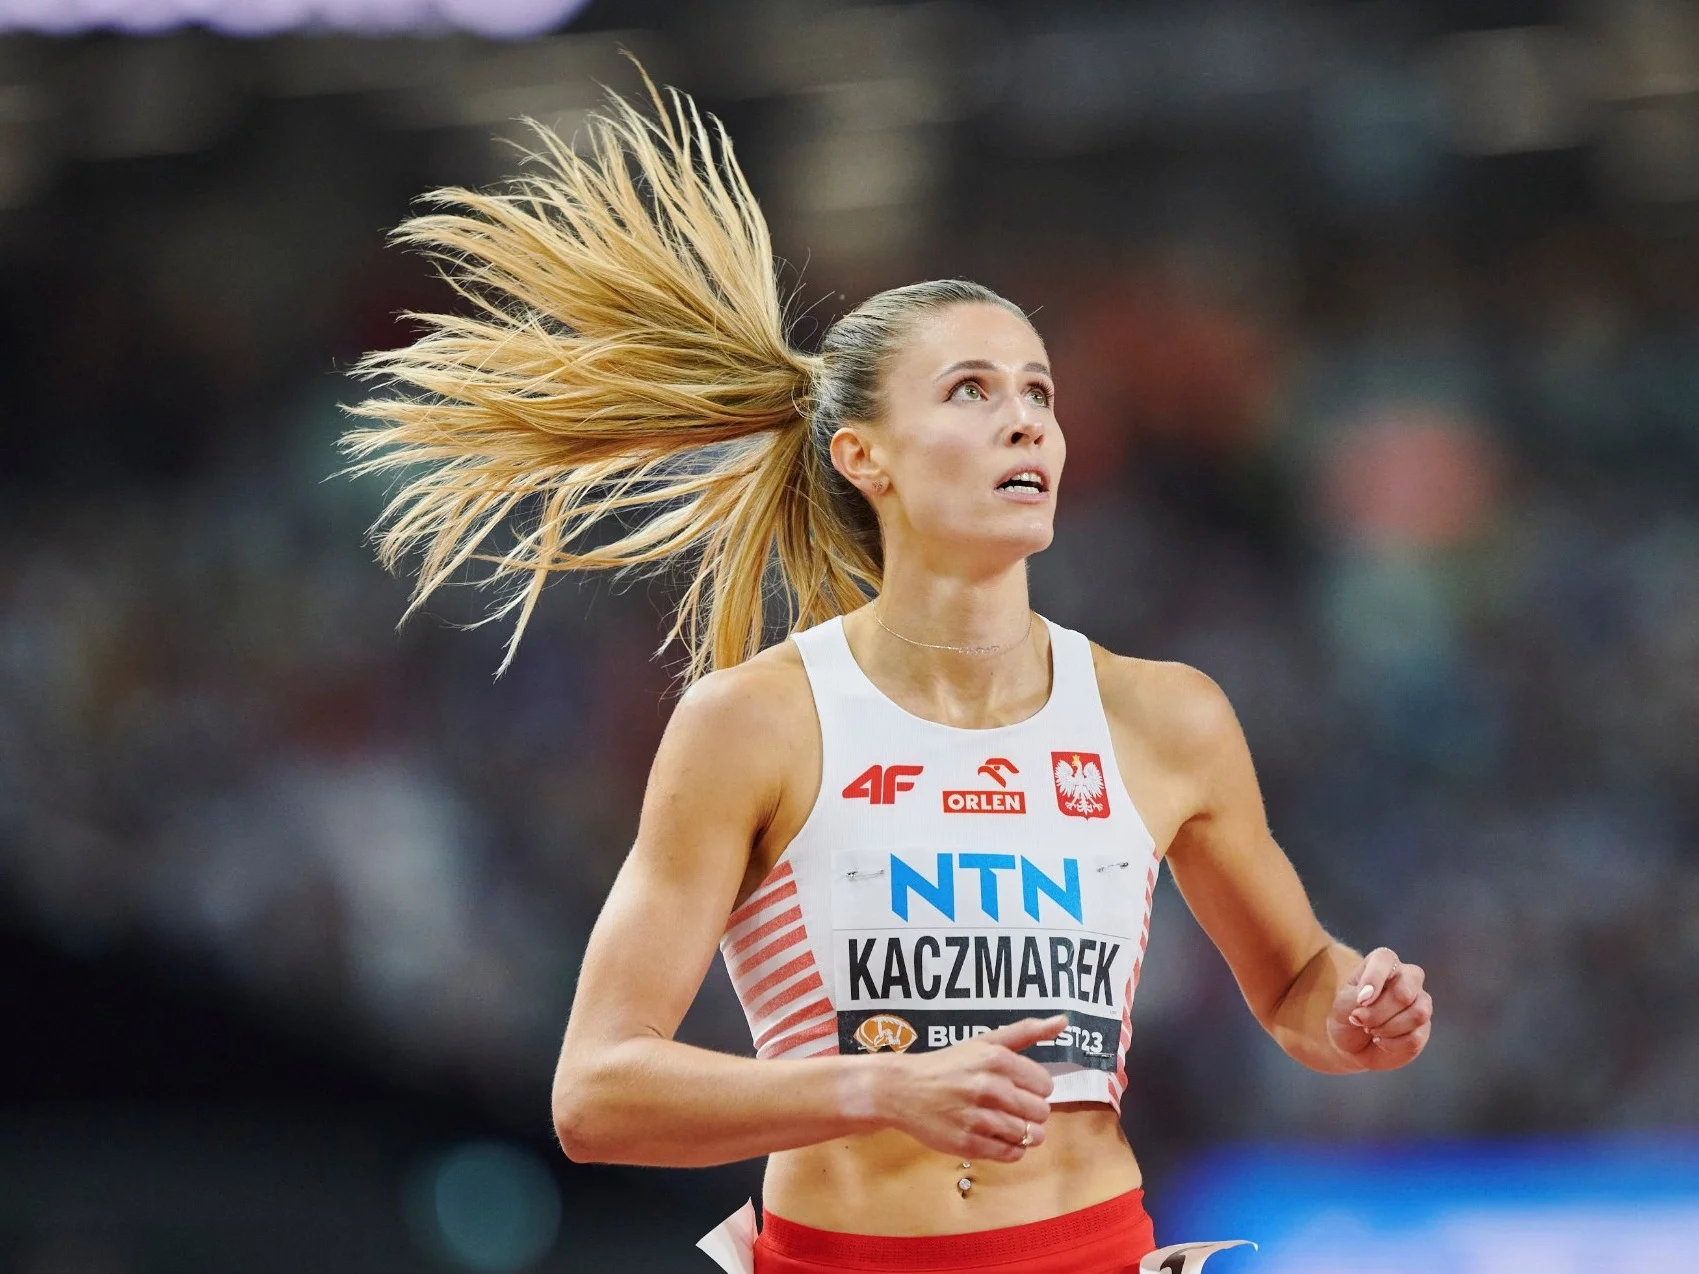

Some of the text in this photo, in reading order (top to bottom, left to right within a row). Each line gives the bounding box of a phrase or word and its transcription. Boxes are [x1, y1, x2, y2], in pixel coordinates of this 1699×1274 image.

[842, 764, 924, 805] 4F
[947, 794, 1021, 811] ORLEN
[890, 852, 1084, 925] NTN
[848, 935, 1121, 1006] KACZMAREK
